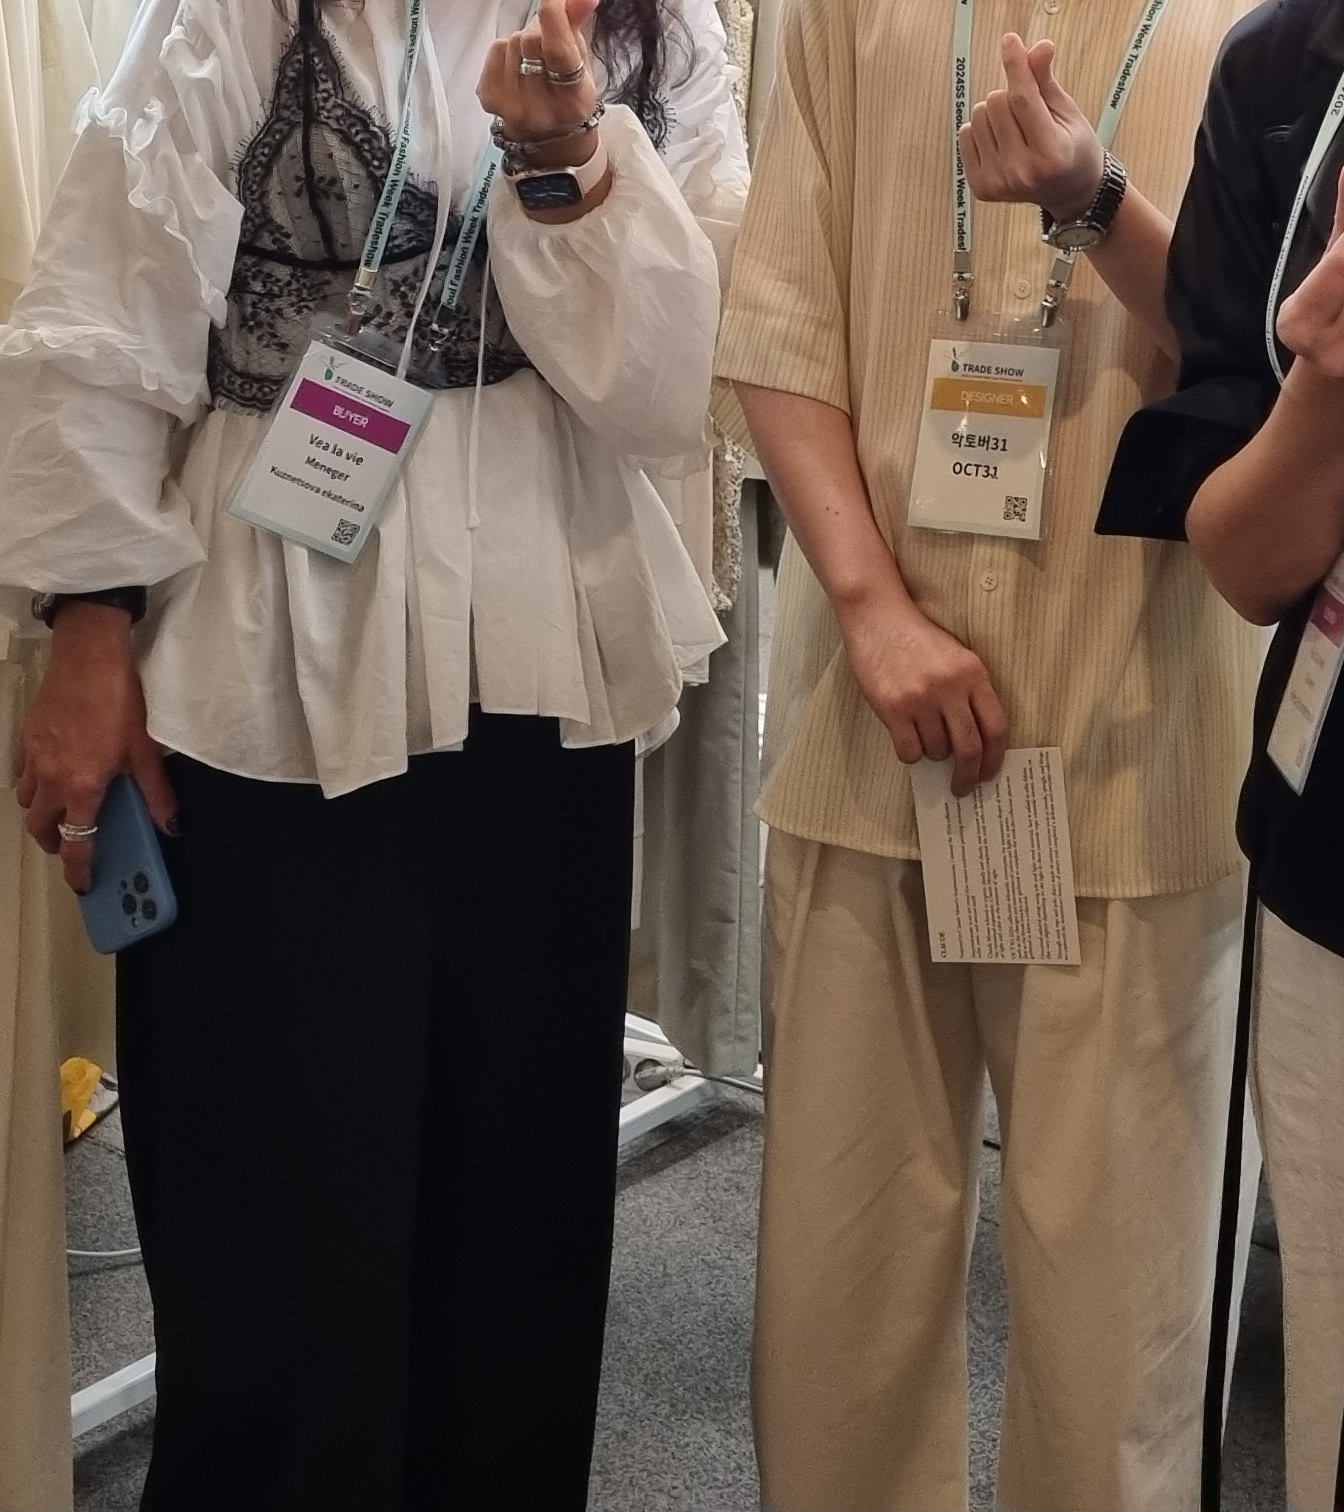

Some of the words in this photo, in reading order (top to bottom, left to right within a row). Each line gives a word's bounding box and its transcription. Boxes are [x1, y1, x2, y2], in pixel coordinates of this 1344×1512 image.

[1132, 24, 1152, 51] Week
[955, 57, 966, 100] 2024SS
[1109, 54, 1139, 110] Tradeshow
[392, 136, 410, 177] Fashion
[381, 179, 401, 208] Week
[956, 177, 965, 209] Week
[449, 246, 469, 288] Fashion
[460, 217, 479, 245] Week
[472, 161, 497, 213] Tradeshow
[363, 211, 390, 268] Tradeshow
[962, 363, 992, 375] TRADE
[994, 366, 1025, 378] SHOW
[335, 376, 366, 395] TRADE
[364, 389, 394, 408] SHOW
[960, 390, 1014, 406] DESIGNER
[332, 404, 369, 429] BUYER
[951, 432, 1008, 452] 악토버31
[345, 452, 364, 466] vie
[952, 461, 999, 479] OCT31
